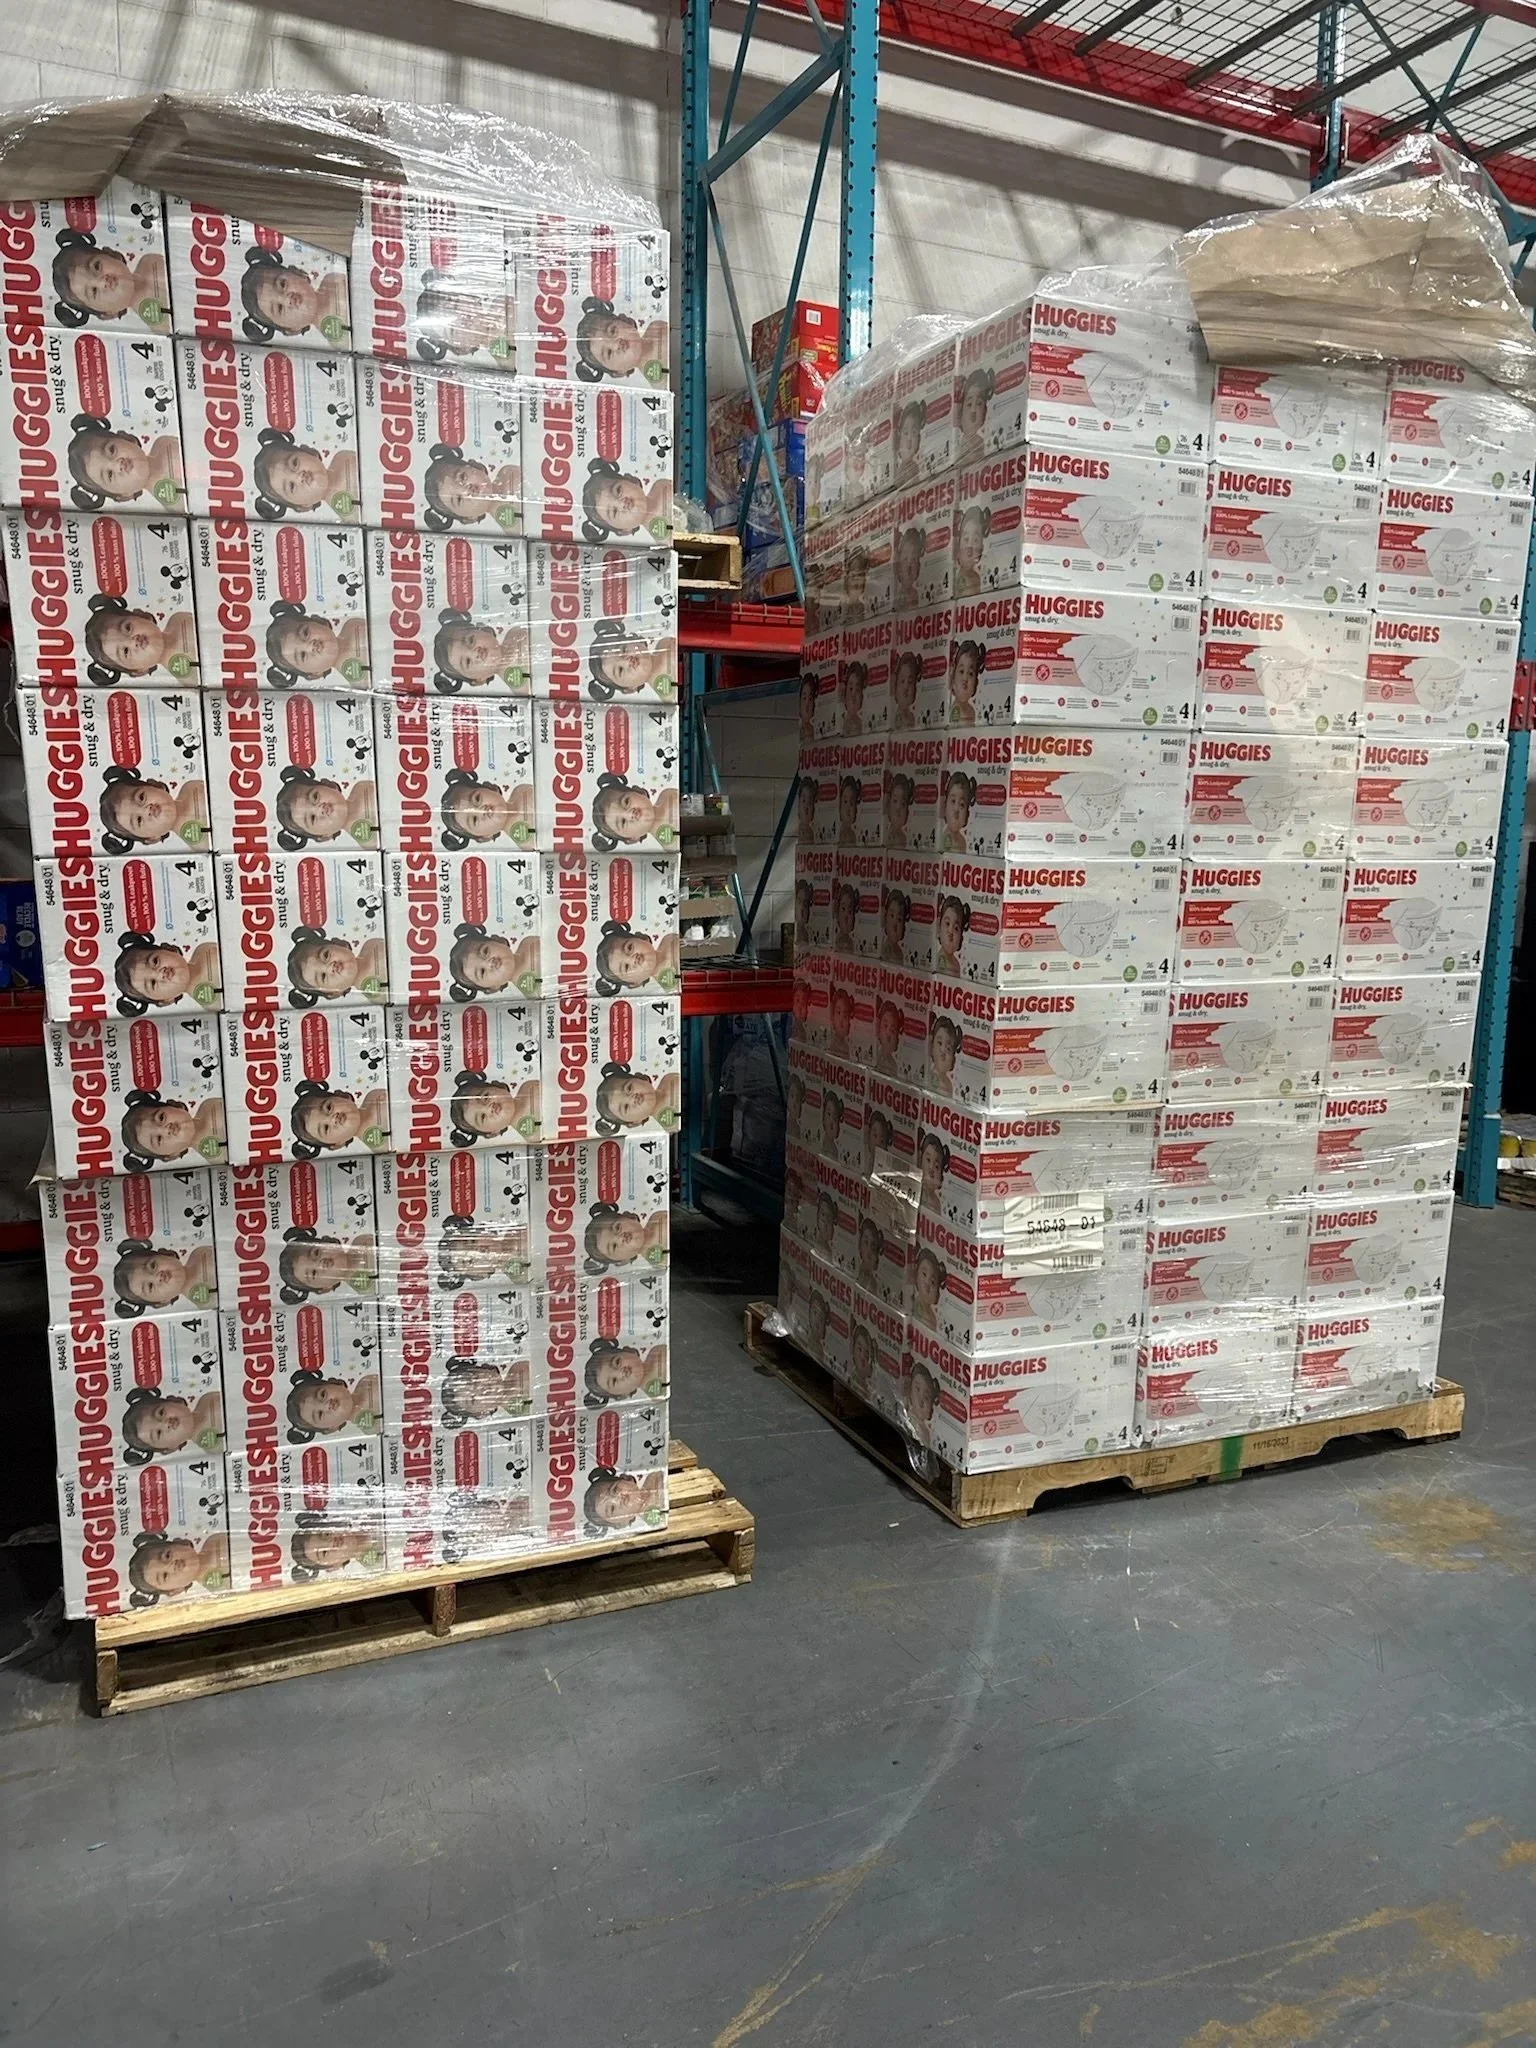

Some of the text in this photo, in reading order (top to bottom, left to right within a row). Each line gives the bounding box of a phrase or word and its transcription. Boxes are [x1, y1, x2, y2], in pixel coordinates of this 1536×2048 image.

[0, 201, 44, 326] HUGG
[190, 202, 232, 341] HUGGI
[534, 214, 566, 382] HUGG
[1034, 302, 1116, 336] HUGGIES
[131, 340, 154, 359] 4
[316, 359, 337, 378] 4
[240, 380, 251, 390] &
[242, 394, 256, 428] snug
[642, 395, 660, 412] 4
[8, 326, 60, 509] HUGGIES
[200, 341, 245, 519] HUGGIES
[1192, 432, 1203, 450] 4
[379, 361, 414, 530] HUGGIES
[1029, 450, 1109, 480] HUGGIES
[959, 453, 1026, 501] HUGGIES
[1218, 470, 1292, 497] HUGGIES
[899, 477, 954, 524] HUGGIES
[1387, 488, 1454, 513] HUGGIES
[147, 522, 170, 539] 4
[327, 532, 347, 549] 4
[67, 547, 79, 557] &
[647, 556, 664, 572] 4
[70, 561, 86, 594] snug
[1185, 569, 1195, 586] 4
[24, 510, 78, 687] HUGGIES
[214, 520, 257, 689] HUGGIES
[1025, 593, 1104, 619] HUGGIES
[1509, 593, 1519, 609] 4
[389, 531, 424, 693] HUGGIES
[548, 543, 579, 700] HUGGIES
[955, 596, 1021, 632] HUGGIES
[1212, 607, 1284, 631] HUGGIES
[896, 609, 951, 645] HUGGIES
[1375, 621, 1440, 643] HUGGIES
[161, 695, 183, 711] 4
[336, 698, 355, 714] 4
[1003, 696, 1011, 712] 4
[1179, 702, 1189, 718] 4
[83, 722, 94, 731] &
[649, 710, 666, 725] 4
[85, 735, 101, 767] snug
[890, 740, 943, 765] HUGGIES
[947, 736, 1012, 762] HUGGIES
[1013, 735, 1093, 756] HUGGIES
[1200, 741, 1271, 761] HUGGIES
[1365, 746, 1429, 765] HUGGIES
[41, 688, 92, 857] HUGGIES
[226, 691, 268, 853] HUGGIES
[396, 695, 432, 852] HUGGIES
[552, 701, 583, 852] HUGGIES
[994, 832, 1001, 848] 4
[1166, 834, 1177, 849] 4
[175, 860, 196, 876] 4
[347, 859, 366, 874] 4
[652, 860, 668, 874] 4
[886, 857, 939, 886] HUGGIES
[941, 860, 1005, 895] HUGGIES
[1009, 868, 1086, 886] HUGGIES
[1191, 869, 1261, 886] HUGGIES
[1354, 868, 1417, 885] HUGGIES
[440, 884, 449, 892] &
[589, 883, 597, 891] &
[441, 896, 453, 924] snug
[590, 894, 600, 921] snug
[238, 855, 279, 1013] HUGGIES
[406, 854, 440, 1005] HUGGIES
[557, 854, 587, 998] HUGGIES
[58, 858, 107, 1022] HUGGIES
[987, 961, 995, 977] 4
[1158, 958, 1169, 973] 4
[1322, 954, 1332, 968] 4
[933, 980, 995, 1022] HUGGIES
[998, 996, 1075, 1014] HUGGIES
[1179, 992, 1248, 1009] HUGGIES
[1340, 986, 1403, 1003] HUGGIES
[350, 1012, 369, 1027] 4
[652, 1002, 668, 1015] 4
[181, 1019, 201, 1035] 4
[279, 1042, 289, 1050] &
[280, 1053, 293, 1082] snug
[558, 998, 587, 1139] HUGGIES
[1311, 1070, 1320, 1084] 4
[242, 1012, 282, 1166] HUGGIES
[1147, 1079, 1158, 1093] 4
[67, 1020, 114, 1179] HUGGIES
[1325, 1099, 1387, 1117] HUGGIES
[922, 1097, 982, 1147] HUGGIES
[985, 1120, 1061, 1139] HUGGIES
[1164, 1111, 1234, 1130] HUGGIES
[640, 1141, 656, 1155] 4
[173, 1170, 193, 1186] 4
[337, 1160, 356, 1175] 4
[546, 1140, 575, 1280] HUGGIES
[1316, 1210, 1378, 1230] HUGGIES
[232, 1162, 271, 1311] HUGGIES
[917, 1211, 977, 1269] HUGGIES
[1158, 1226, 1226, 1248] HUGGIES
[61, 1172, 105, 1326] HUGGIES
[344, 1302, 362, 1318] 4
[1127, 1313, 1137, 1327] 4
[182, 1318, 201, 1334] 4
[1308, 1318, 1369, 1341] HUGGIES
[109, 1352, 119, 1361] &
[546, 1277, 576, 1416] HUGGIES
[911, 1326, 971, 1389] HUGGIES
[111, 1362, 124, 1392] snug
[240, 1307, 278, 1452] HUGGIES
[973, 1357, 1047, 1380] HUGGIES
[71, 1324, 114, 1475] HUGGIES
[348, 1442, 366, 1458] 4
[189, 1461, 208, 1477] 4
[546, 1411, 576, 1546] HUGGIES
[401, 1432, 433, 1570] HGIES
[247, 1449, 282, 1591] HUGGIES
[79, 1469, 120, 1620] HUGGIES
